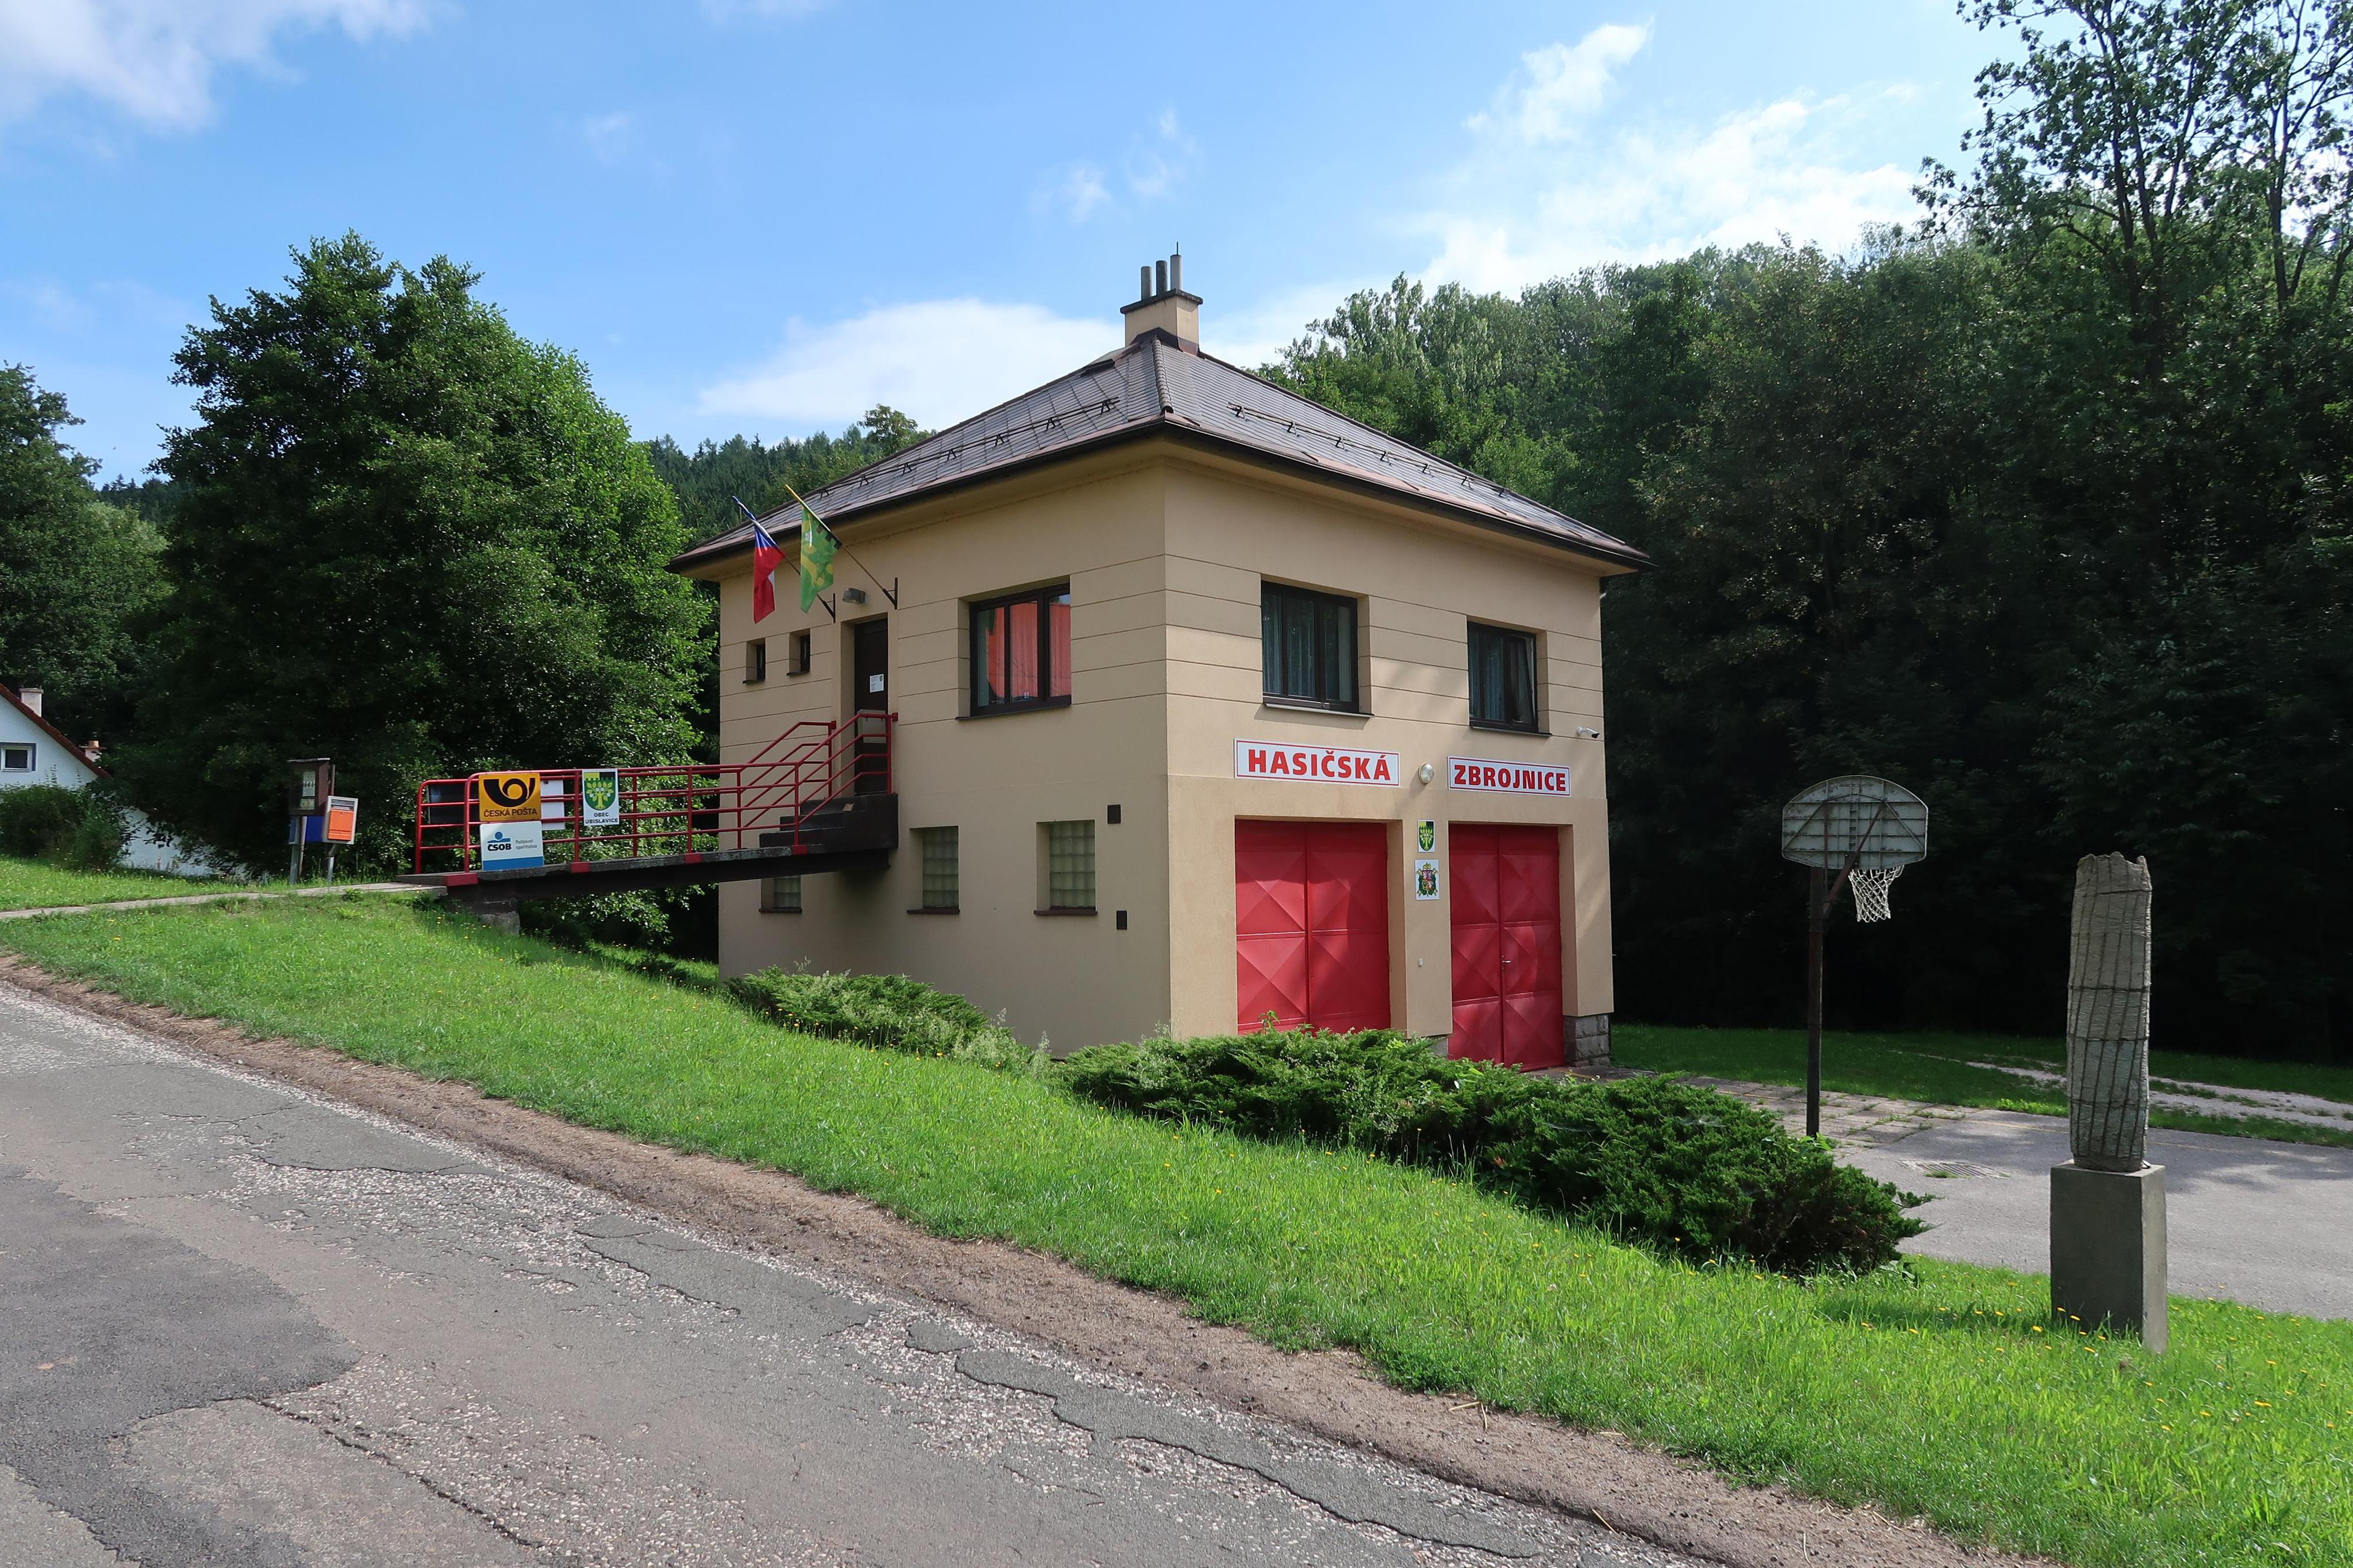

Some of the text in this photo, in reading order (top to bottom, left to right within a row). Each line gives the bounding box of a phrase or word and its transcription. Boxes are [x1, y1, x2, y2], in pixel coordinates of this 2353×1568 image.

[1248, 749, 1391, 780] HASIČSKÁ
[1455, 765, 1566, 791] ZBROJNICE
[484, 808, 537, 817] ČESKÁ POŠTA
